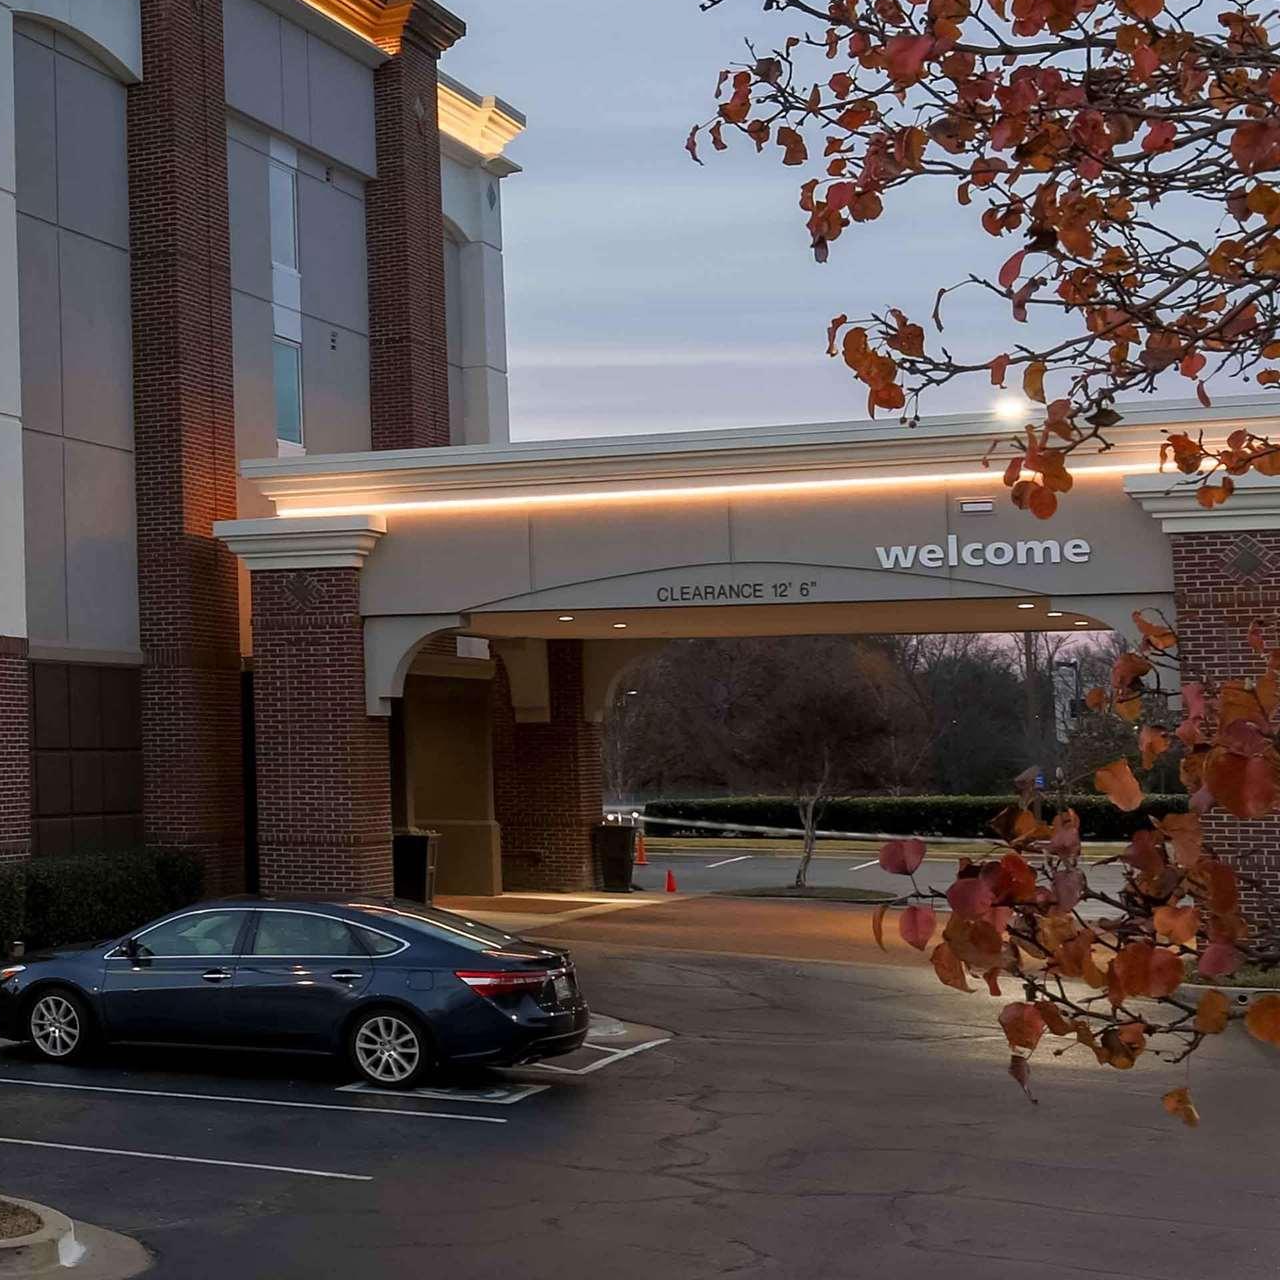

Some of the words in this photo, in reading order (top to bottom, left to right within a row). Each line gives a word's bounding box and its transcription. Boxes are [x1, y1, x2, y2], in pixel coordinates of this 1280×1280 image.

[875, 534, 1091, 569] welcome
[656, 583, 764, 602] CLEARANCE
[771, 582, 792, 598] 12'
[799, 581, 817, 597] 6"
